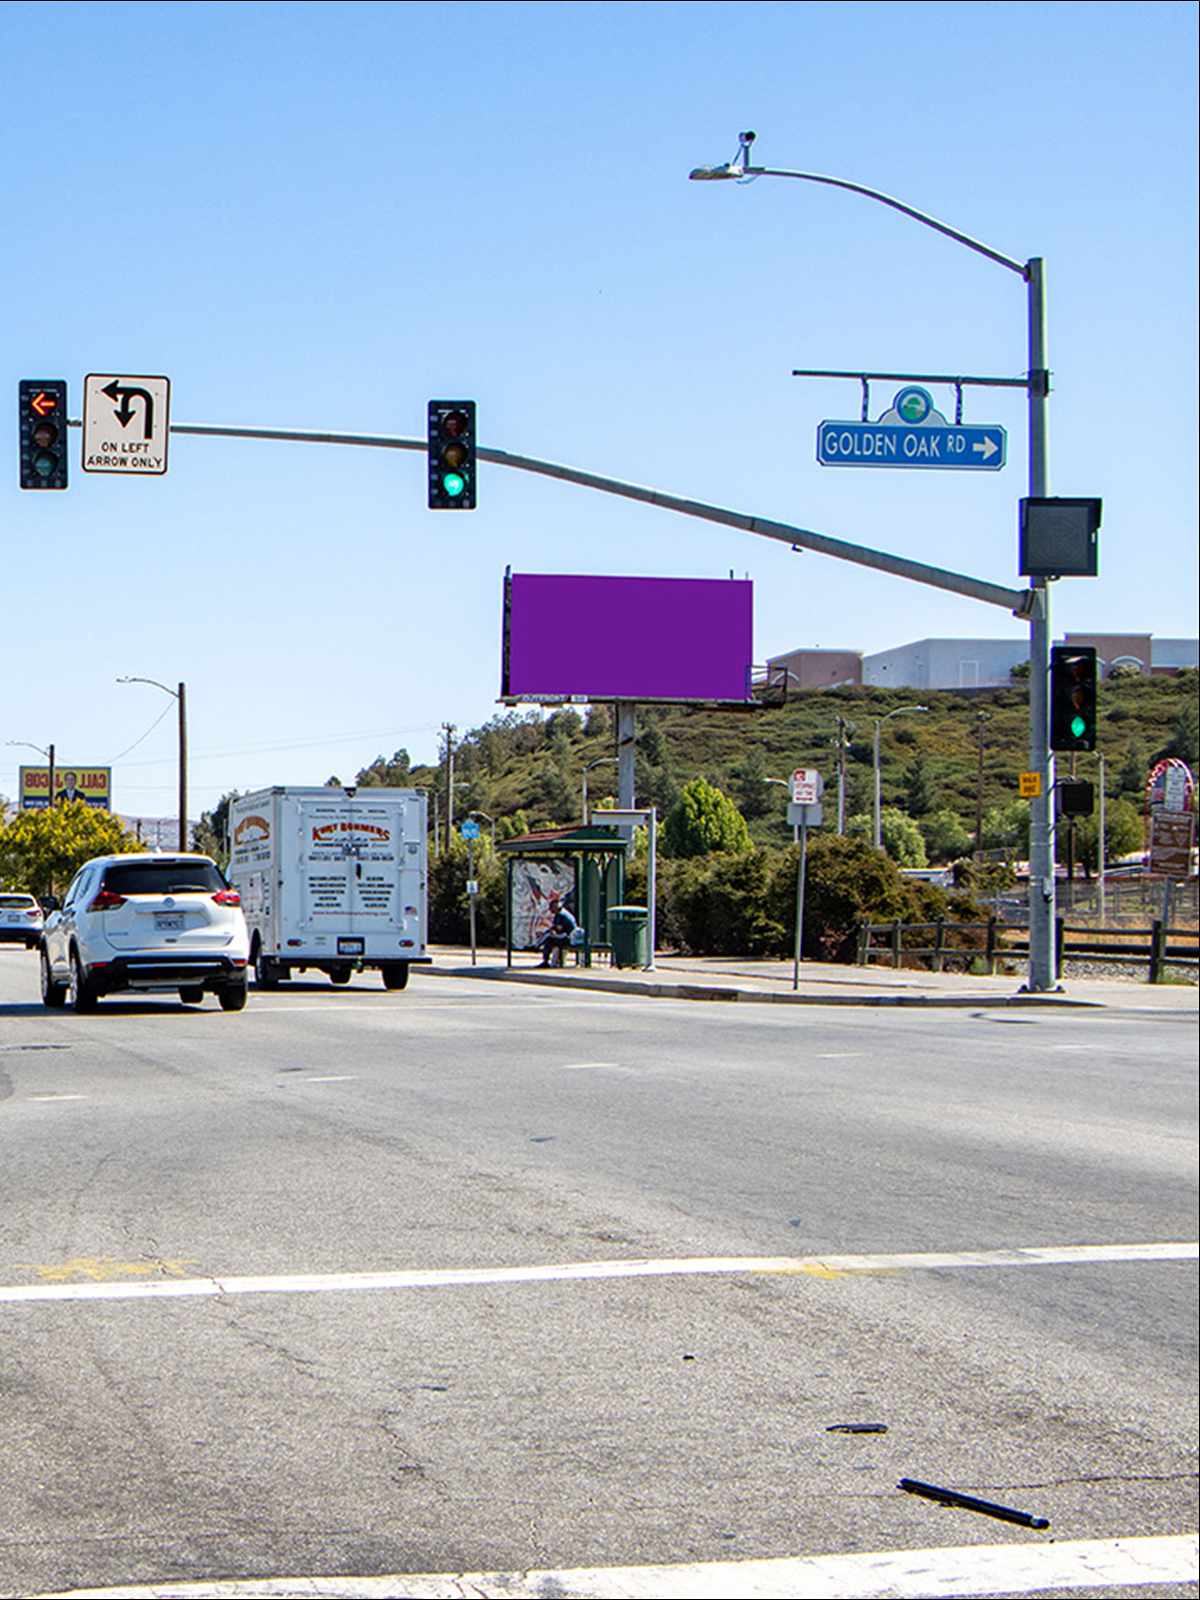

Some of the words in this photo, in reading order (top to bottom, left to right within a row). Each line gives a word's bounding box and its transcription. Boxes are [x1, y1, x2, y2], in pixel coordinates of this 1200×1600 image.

[101, 441, 118, 452] ON
[121, 442, 150, 454] LEFT
[825, 431, 897, 456] GOLDEN
[903, 433, 941, 458] OAK
[947, 434, 966, 453] RD
[87, 455, 128, 467] ARROW
[131, 456, 163, 468] ONLY
[312, 823, 339, 841] KURT
